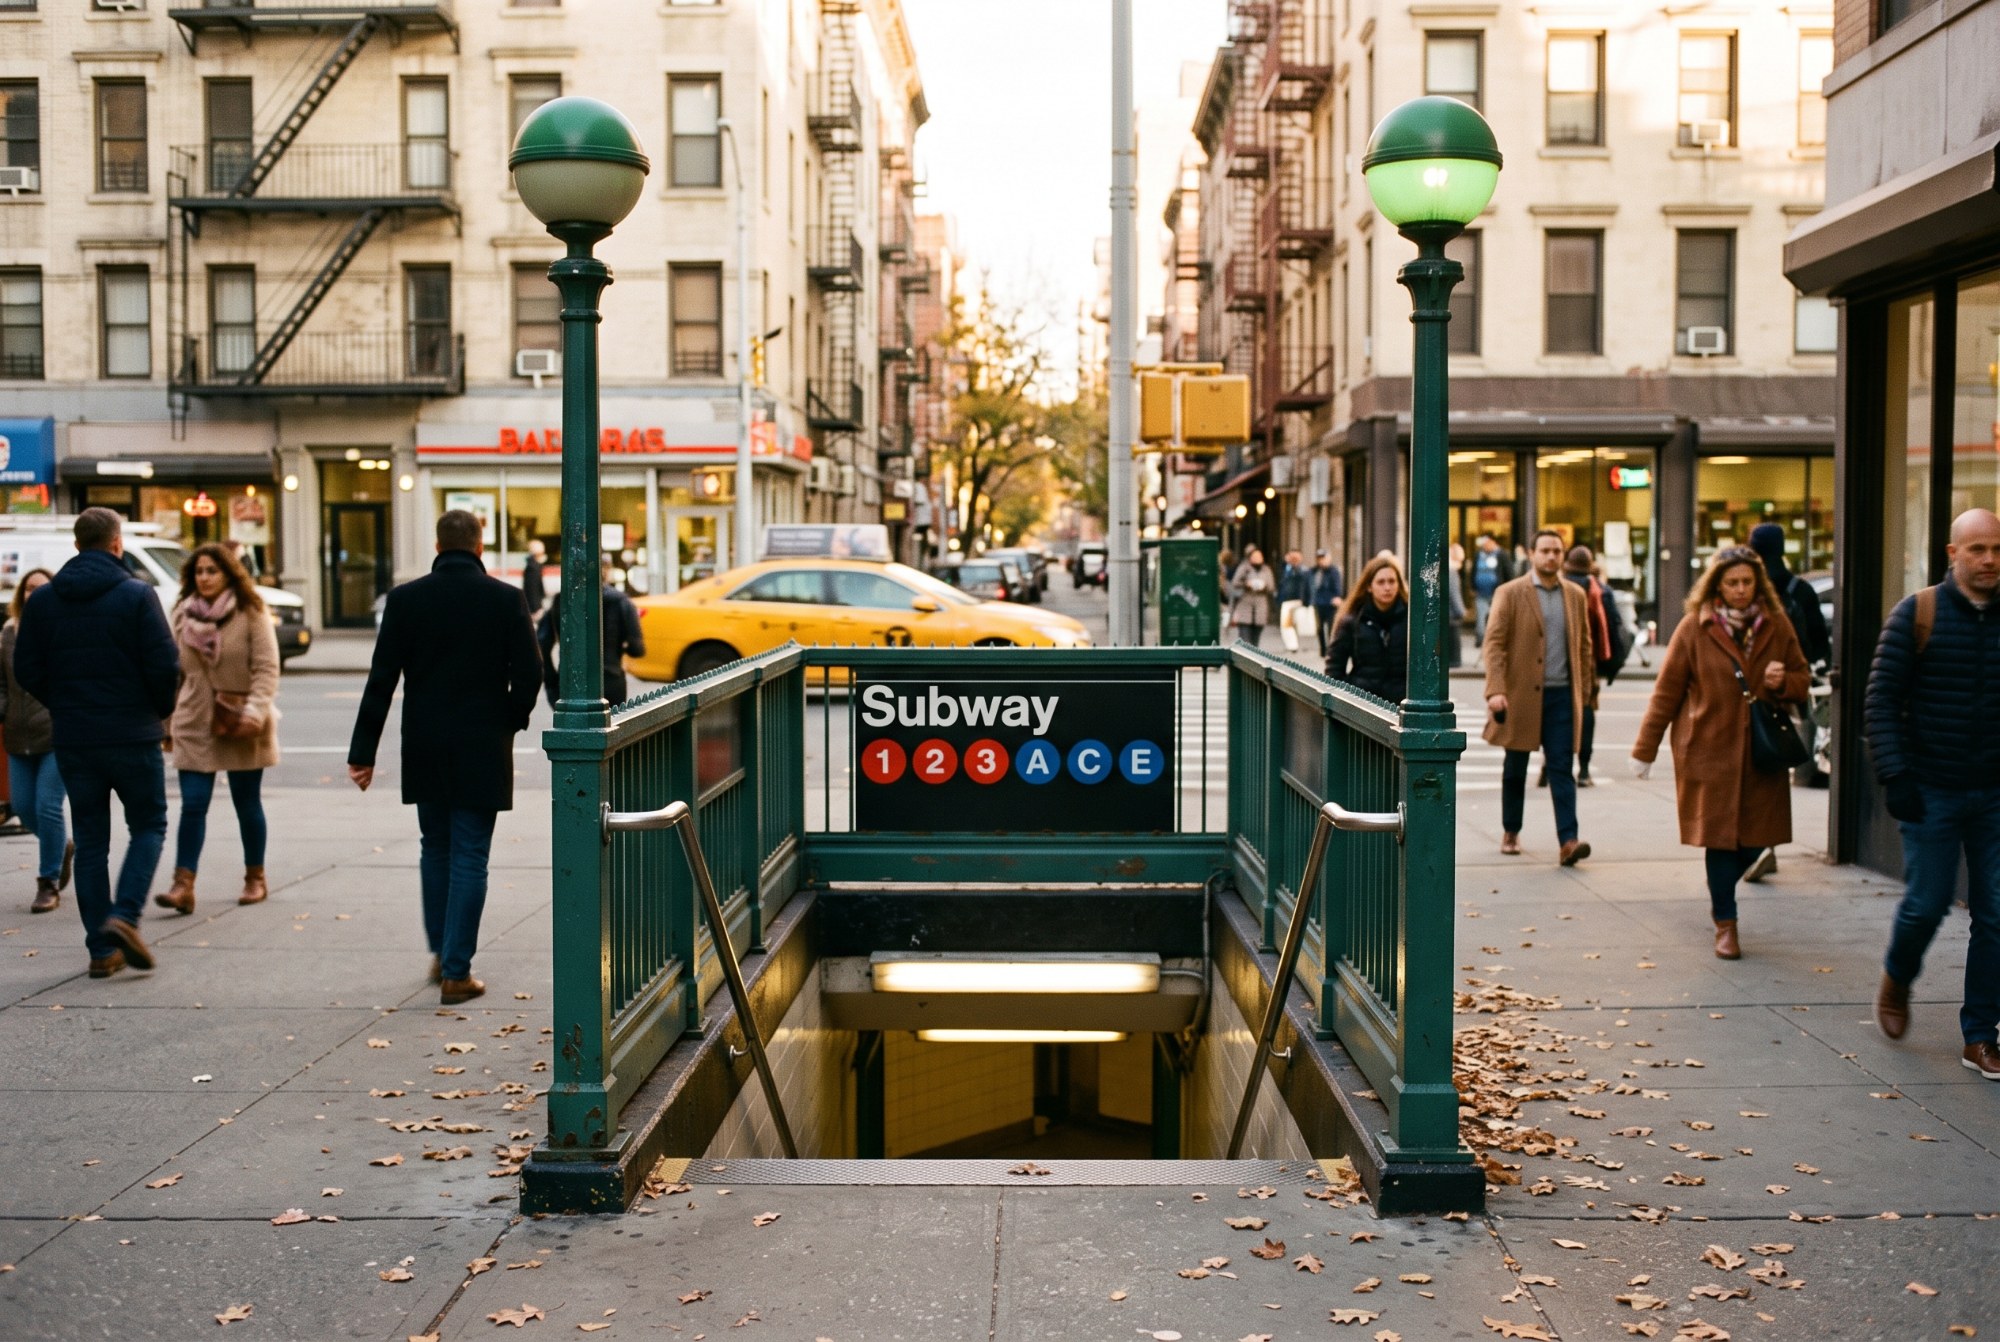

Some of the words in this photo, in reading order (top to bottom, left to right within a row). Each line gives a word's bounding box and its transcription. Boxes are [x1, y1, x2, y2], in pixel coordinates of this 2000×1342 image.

[861, 684, 1059, 736] Subway
[876, 748, 889, 774] 1
[925, 748, 945, 774] 2
[976, 748, 996, 774] 3
[1025, 748, 1050, 775] A
[1077, 748, 1101, 775] C
[1131, 748, 1151, 775] E
